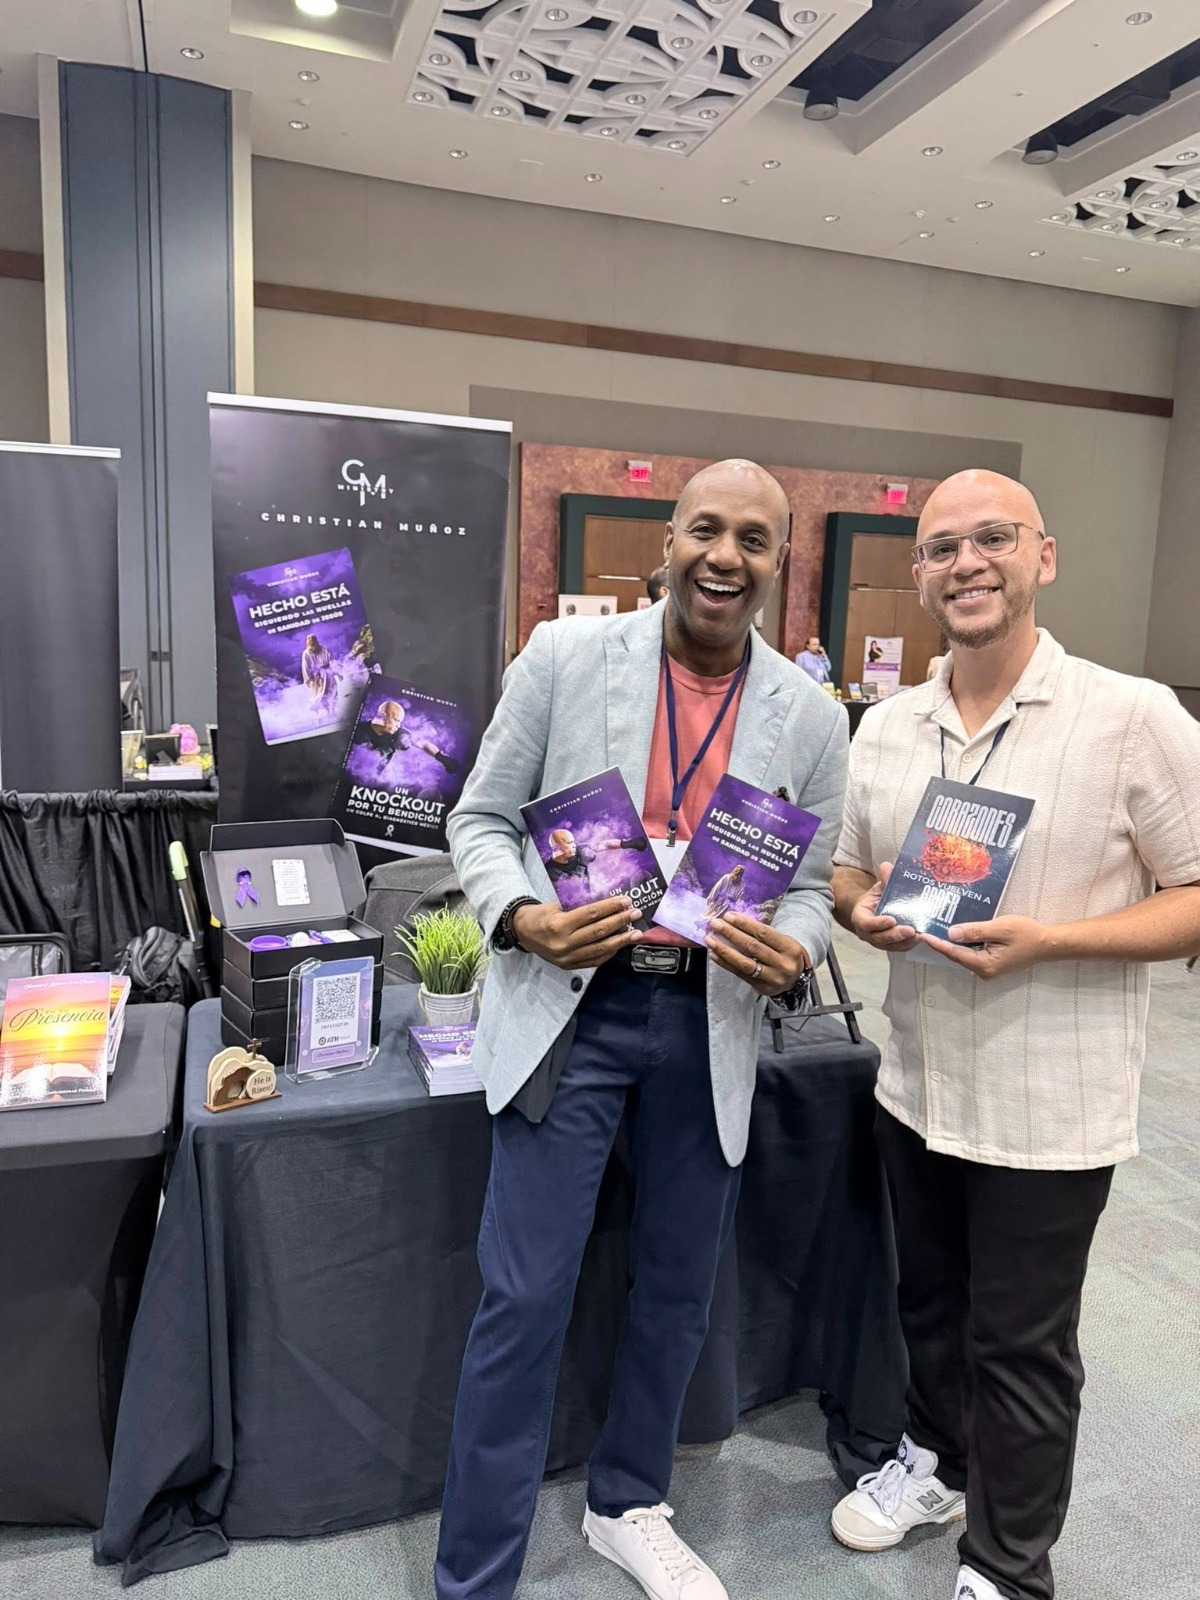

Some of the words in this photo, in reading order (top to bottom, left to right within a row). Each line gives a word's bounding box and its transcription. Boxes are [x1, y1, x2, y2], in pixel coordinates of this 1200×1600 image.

[261, 512, 383, 530] CHRISTIAN
[399, 523, 466, 536] MUÑOZ
[248, 595, 308, 619] HECHO
[310, 583, 351, 604] ESTÁ
[254, 612, 300, 628] SIGUIENDO
[316, 599, 352, 614] HUELLAS
[277, 619, 311, 632] SANIDAD
[321, 611, 344, 622] JESÚS
[350, 785, 446, 815] KNOCKOUT
[395, 786, 409, 796] UN
[347, 799, 370, 810] POR
[372, 804, 386, 813] TU
[388, 807, 442, 824] BENDICIÓN
[925, 794, 1017, 849] CORAZONES
[706, 822, 747, 845] SIGUIENDO
[748, 842, 760, 852] LAS
[760, 847, 794, 869] HUELLAS
[710, 807, 762, 840] HECHO
[763, 832, 801, 860] ESTÁ
[720, 839, 751, 858] SANIDAD
[759, 858, 780, 872] JESÚS
[609, 886, 622, 897] UN
[903, 870, 936, 886] ROTOS
[937, 881, 983, 902] VUELVEN
[982, 896, 991, 905] A
[9, 1008, 105, 1033] Presencia
[251, 1083, 273, 1095] Risen!
[254, 1077, 265, 1085] He
